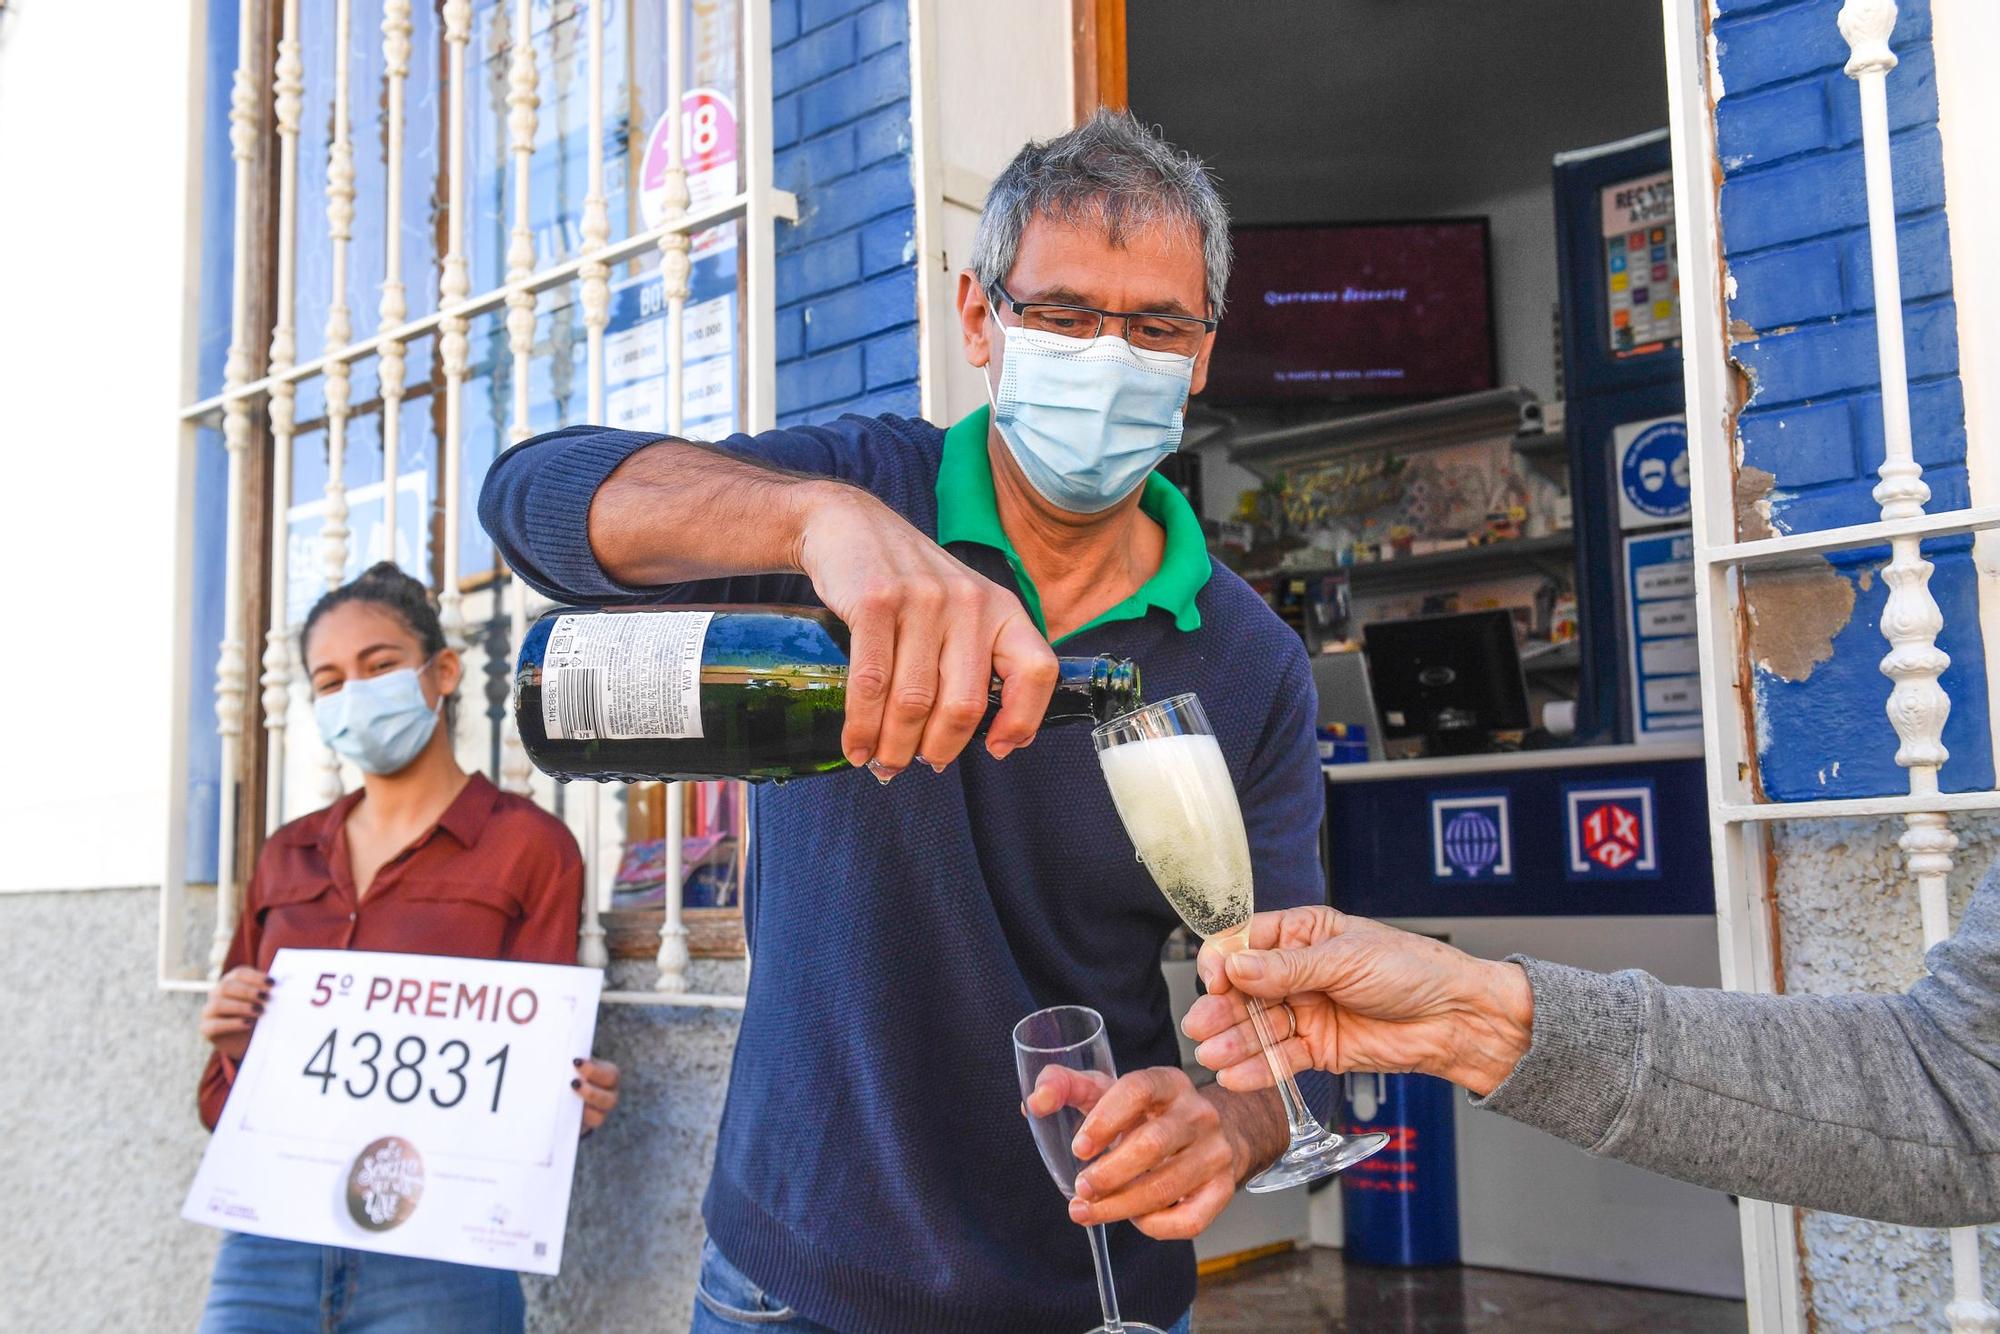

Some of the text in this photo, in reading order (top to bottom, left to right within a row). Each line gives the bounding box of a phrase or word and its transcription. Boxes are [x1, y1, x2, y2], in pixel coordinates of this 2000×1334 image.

[684, 614, 705, 665] ARESTEL
[682, 669, 692, 691] CAVA
[365, 976, 539, 1026] PREMIO
[301, 1027, 511, 1114] 43831
